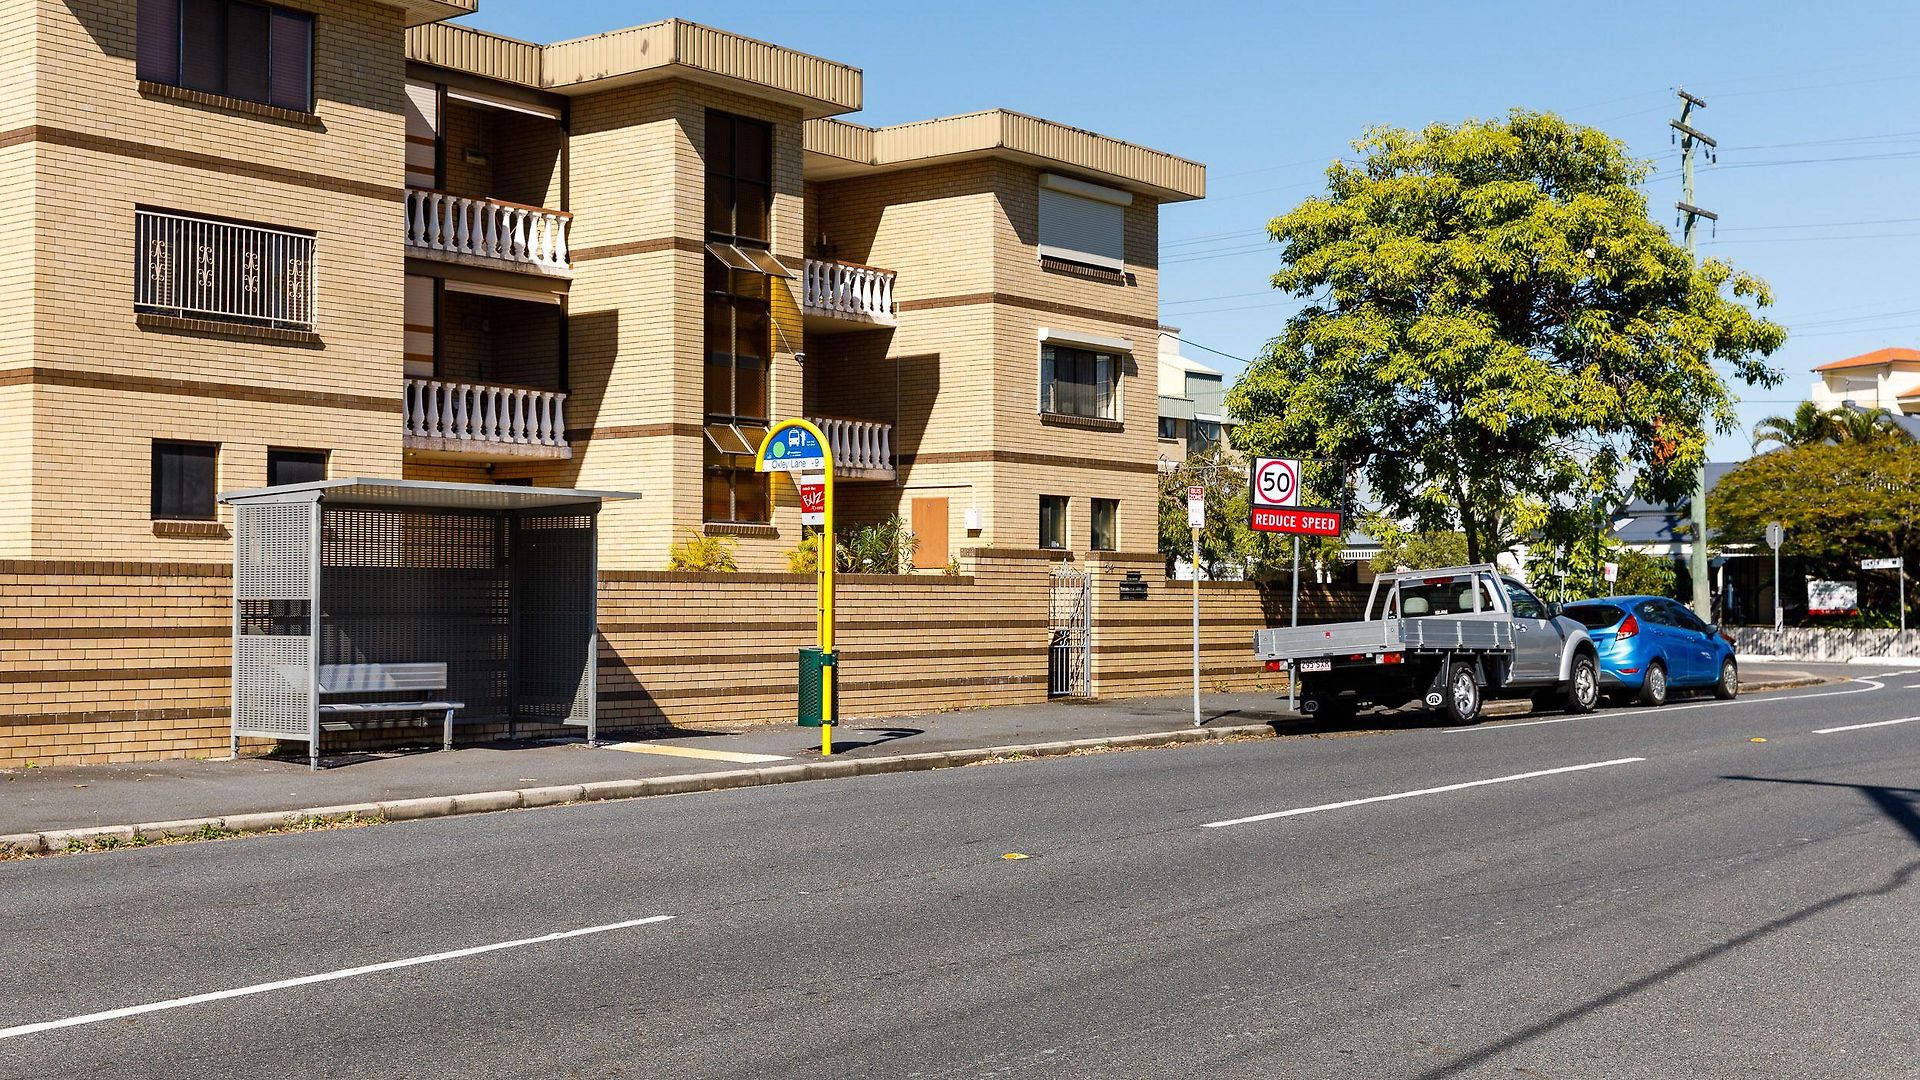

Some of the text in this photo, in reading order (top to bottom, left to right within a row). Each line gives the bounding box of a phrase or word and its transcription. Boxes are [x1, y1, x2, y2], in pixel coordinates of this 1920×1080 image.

[771, 460, 789, 470] Oxley
[791, 459, 807, 468] Lane
[1263, 471, 1290, 492] 50
[1255, 513, 1336, 530] REDUCE SPEED
